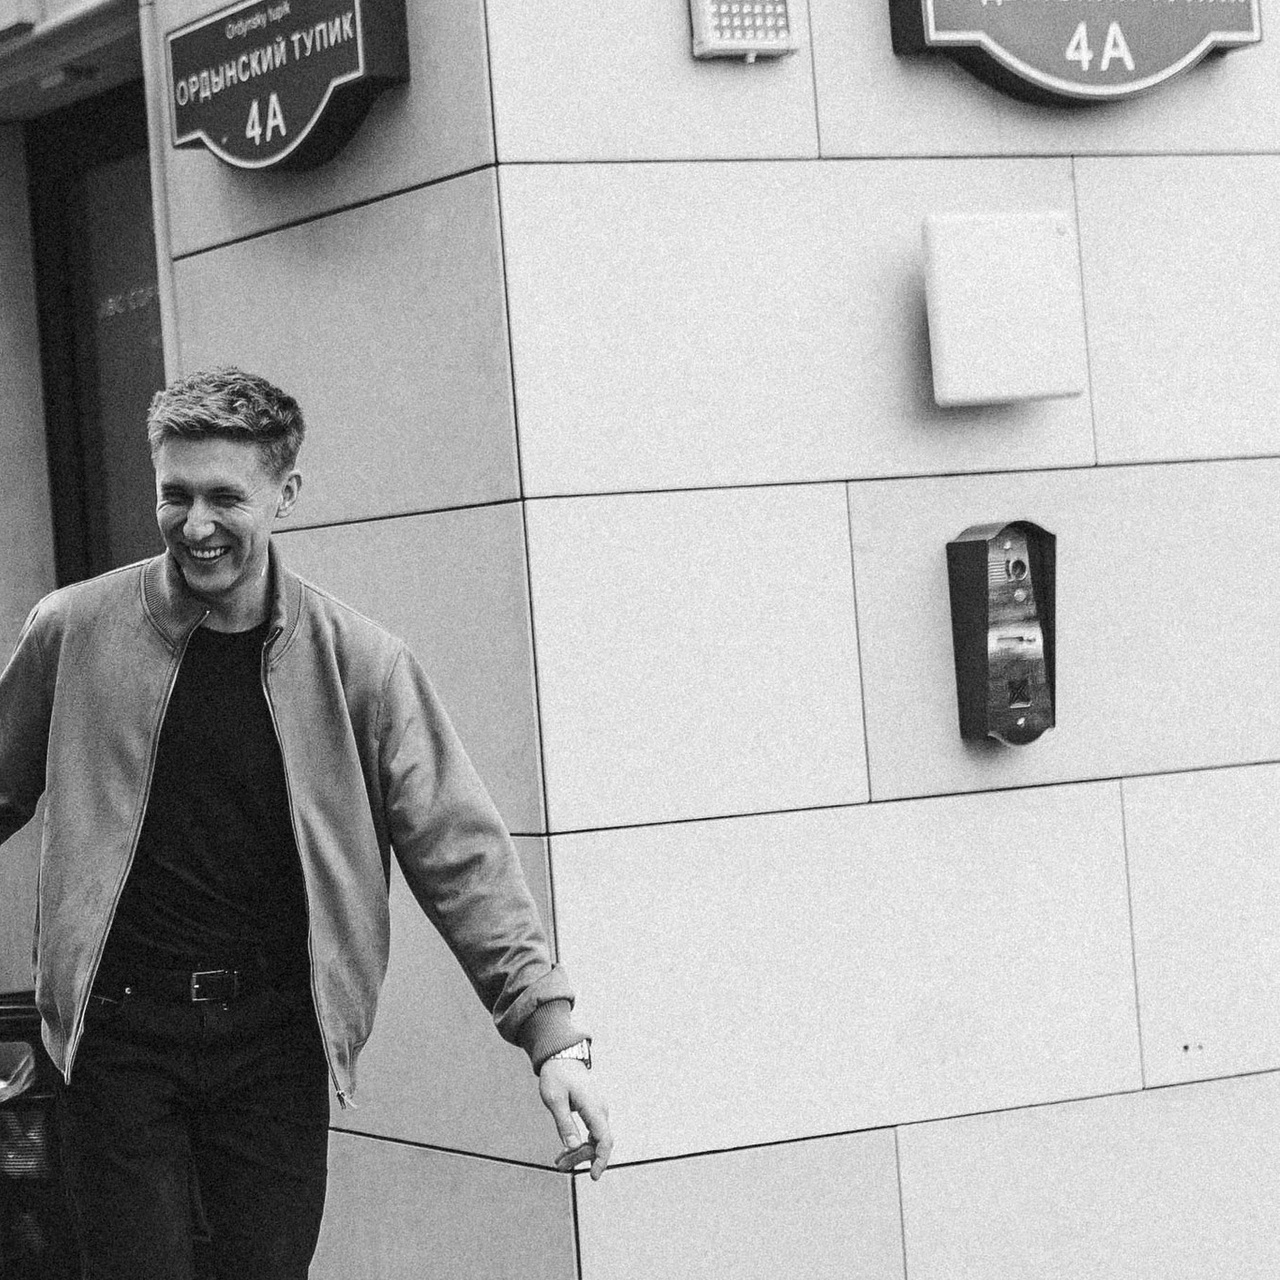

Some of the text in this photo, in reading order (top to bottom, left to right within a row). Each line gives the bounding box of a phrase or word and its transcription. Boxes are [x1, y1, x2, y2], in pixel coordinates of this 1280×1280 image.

[176, 11, 354, 106] ОРДЫНСКИЙ ТУПИК
[1065, 22, 1135, 71] 4А
[245, 92, 287, 146] 4А
